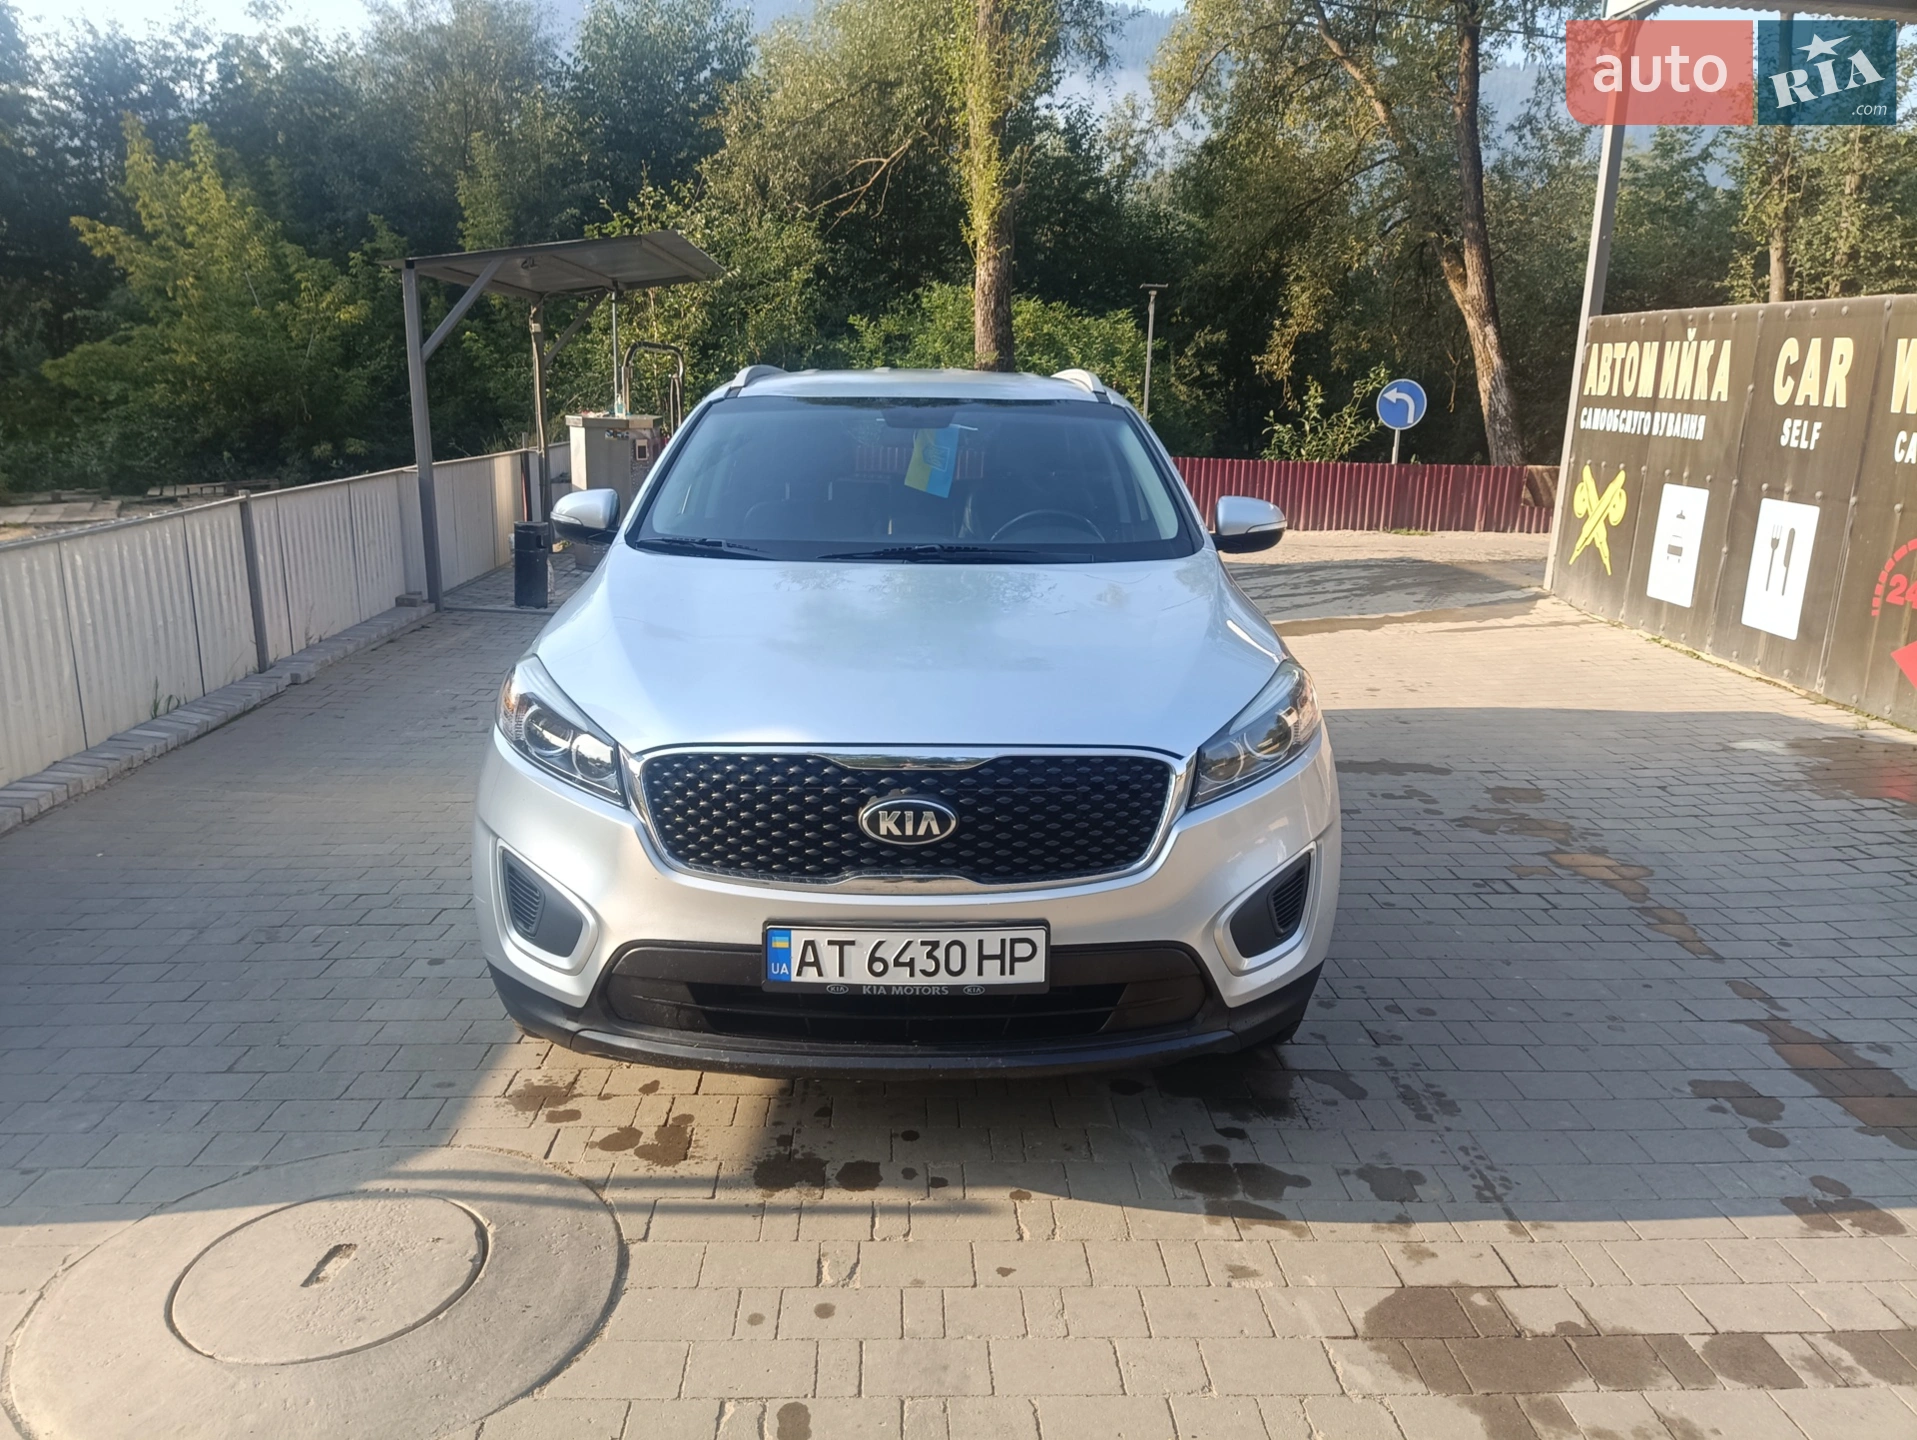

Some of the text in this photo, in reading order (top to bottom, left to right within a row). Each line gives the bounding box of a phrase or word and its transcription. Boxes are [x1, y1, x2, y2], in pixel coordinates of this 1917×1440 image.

[1773, 337, 1854, 408] CAR
[1780, 418, 1822, 450] SELF
[879, 810, 941, 836] KIA
[771, 963, 789, 975] UA
[796, 938, 1037, 978] AT 6430 HP
[862, 985, 949, 996] KIA MOTORS
